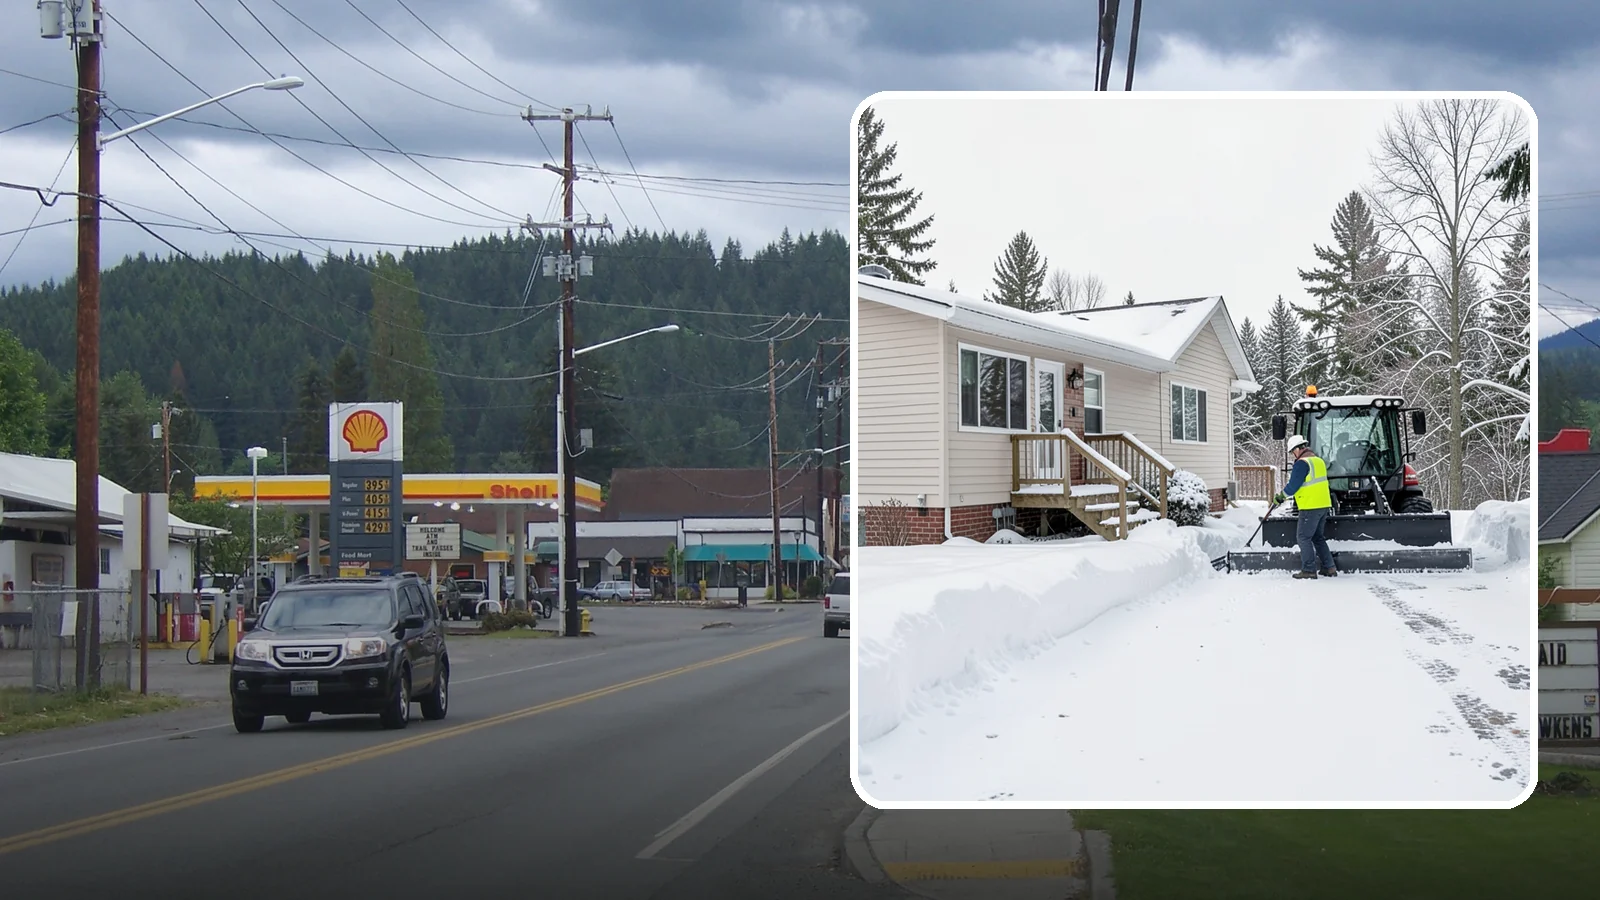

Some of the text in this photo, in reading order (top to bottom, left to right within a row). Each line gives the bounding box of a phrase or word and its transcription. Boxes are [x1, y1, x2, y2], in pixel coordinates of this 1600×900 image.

[366, 480, 383, 490] 395
[490, 484, 547, 499] Shell
[366, 494, 383, 504] 405
[366, 508, 383, 518] 415
[366, 522, 383, 532] 429
[1539, 716, 1592, 739] WKENS
